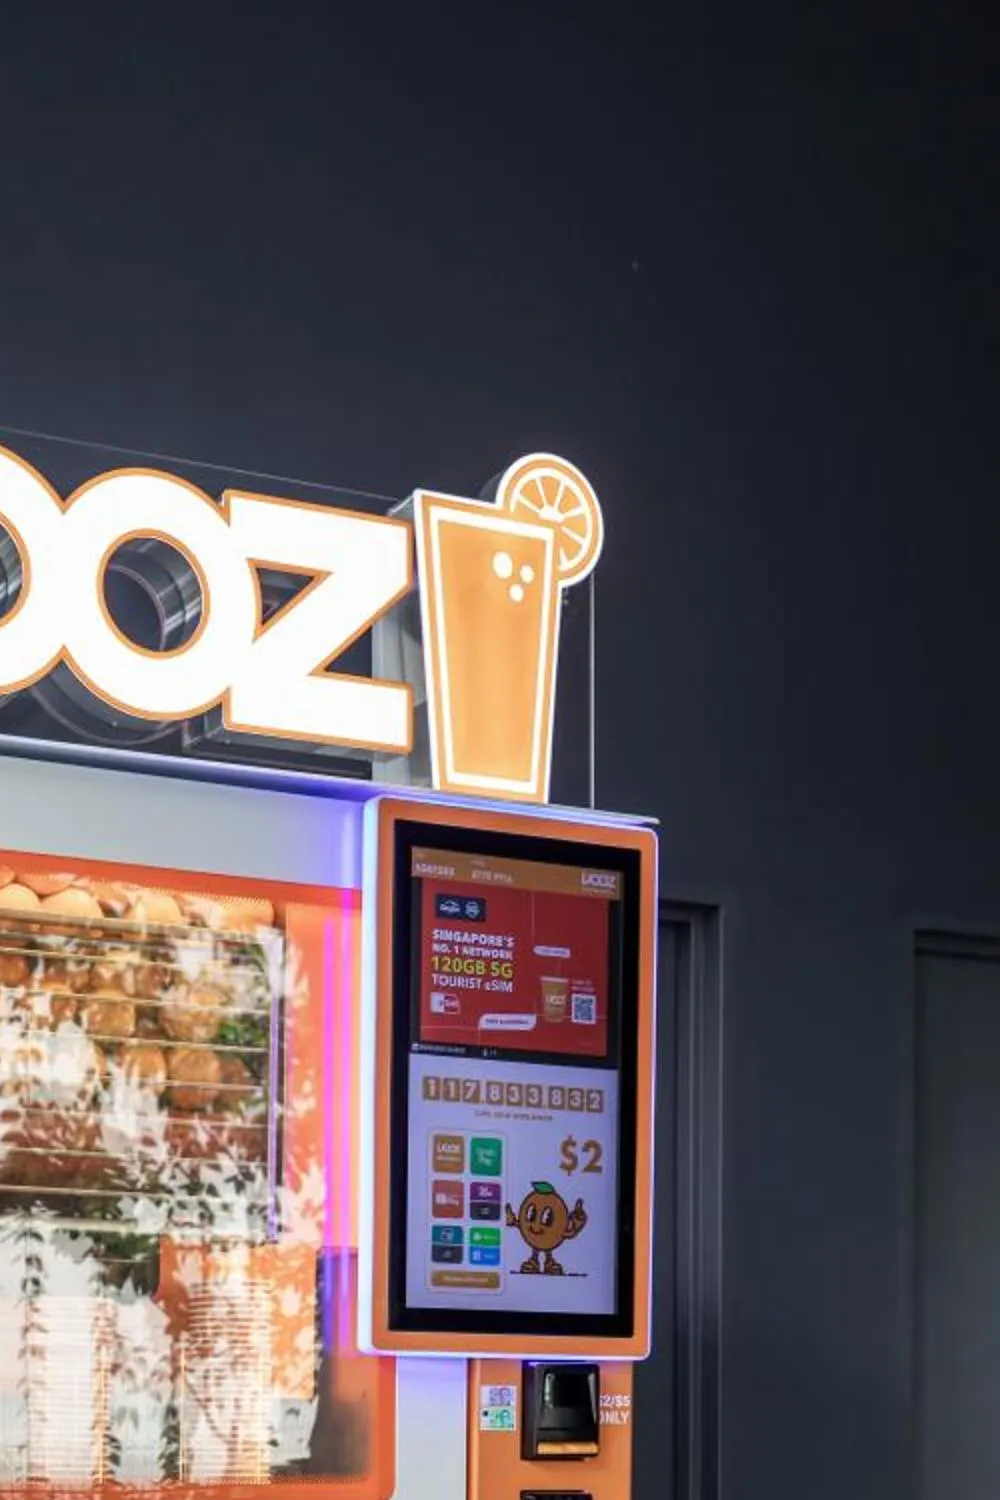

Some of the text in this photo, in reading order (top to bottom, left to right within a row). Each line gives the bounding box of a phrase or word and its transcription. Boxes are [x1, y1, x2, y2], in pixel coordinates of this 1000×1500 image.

[431, 928, 515, 949] SINGAPORE'S
[462, 945, 514, 961] NETWORK
[431, 955, 514, 979] 120GB 5G
[431, 973, 482, 990] TOURIST
[559, 1134, 603, 1177] $2
